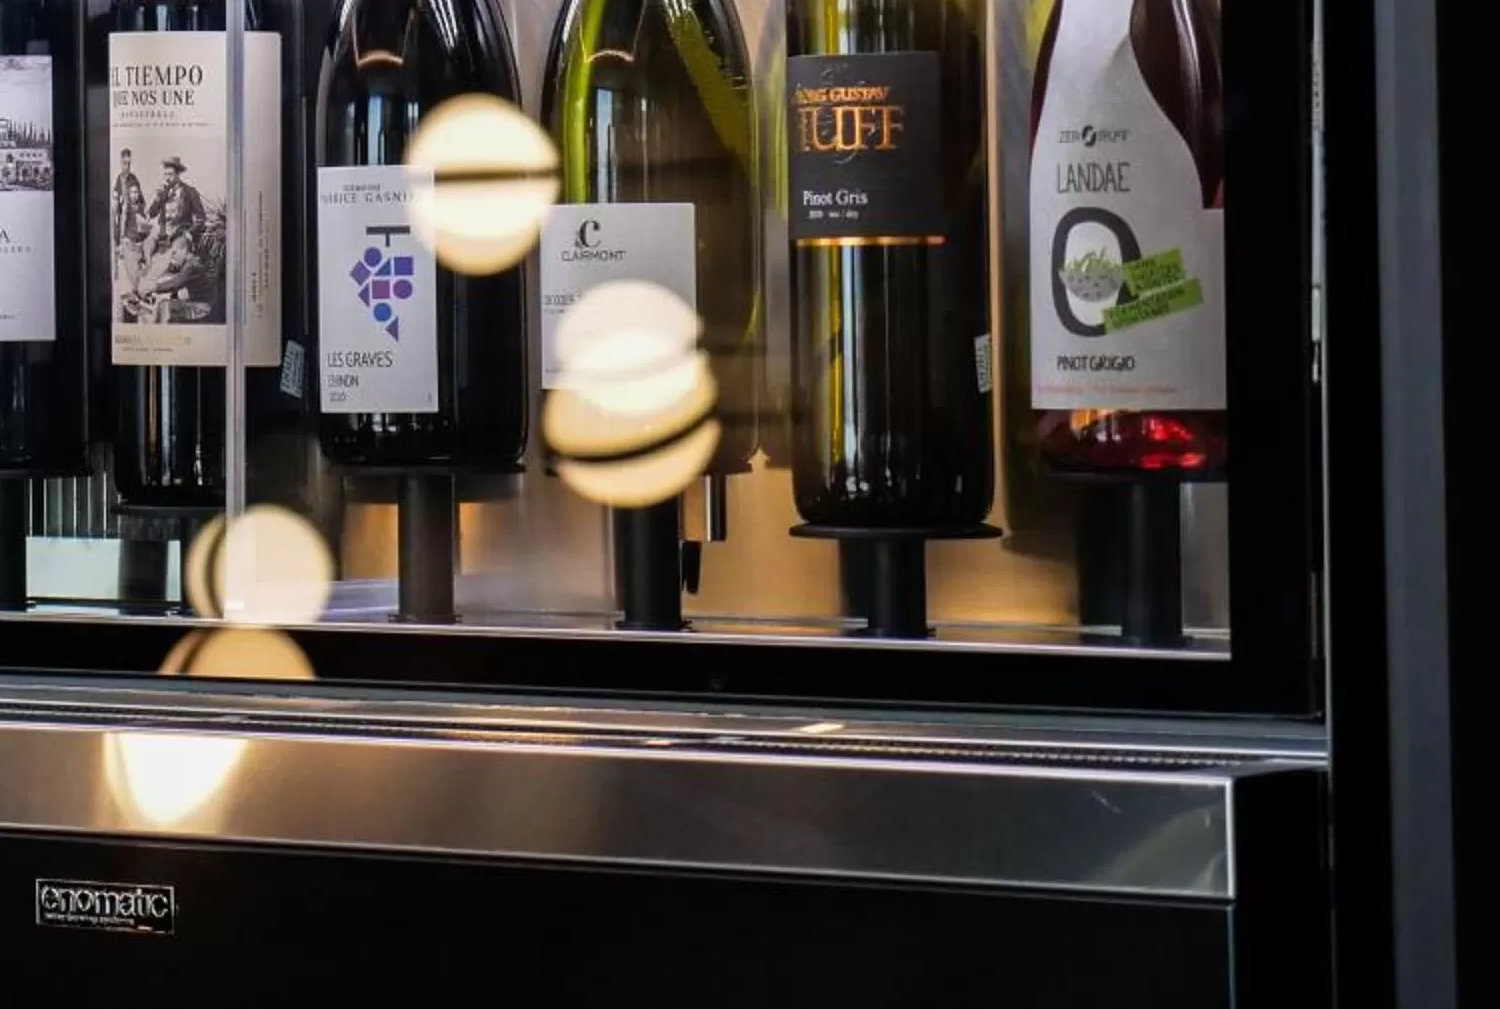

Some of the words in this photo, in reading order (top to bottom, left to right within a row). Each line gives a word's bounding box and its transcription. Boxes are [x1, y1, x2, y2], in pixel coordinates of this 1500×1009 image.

[125, 64, 204, 87] TIEMPO
[131, 90, 158, 106] NOS
[162, 90, 196, 106] UNE
[1056, 161, 1132, 195] LANDAE
[802, 190, 833, 206] Pinot
[835, 188, 869, 205] Gris
[327, 351, 344, 368] LES
[344, 351, 394, 368] GRAVES
[1056, 354, 1089, 371] PINOT
[40, 885, 169, 918] enomatic
